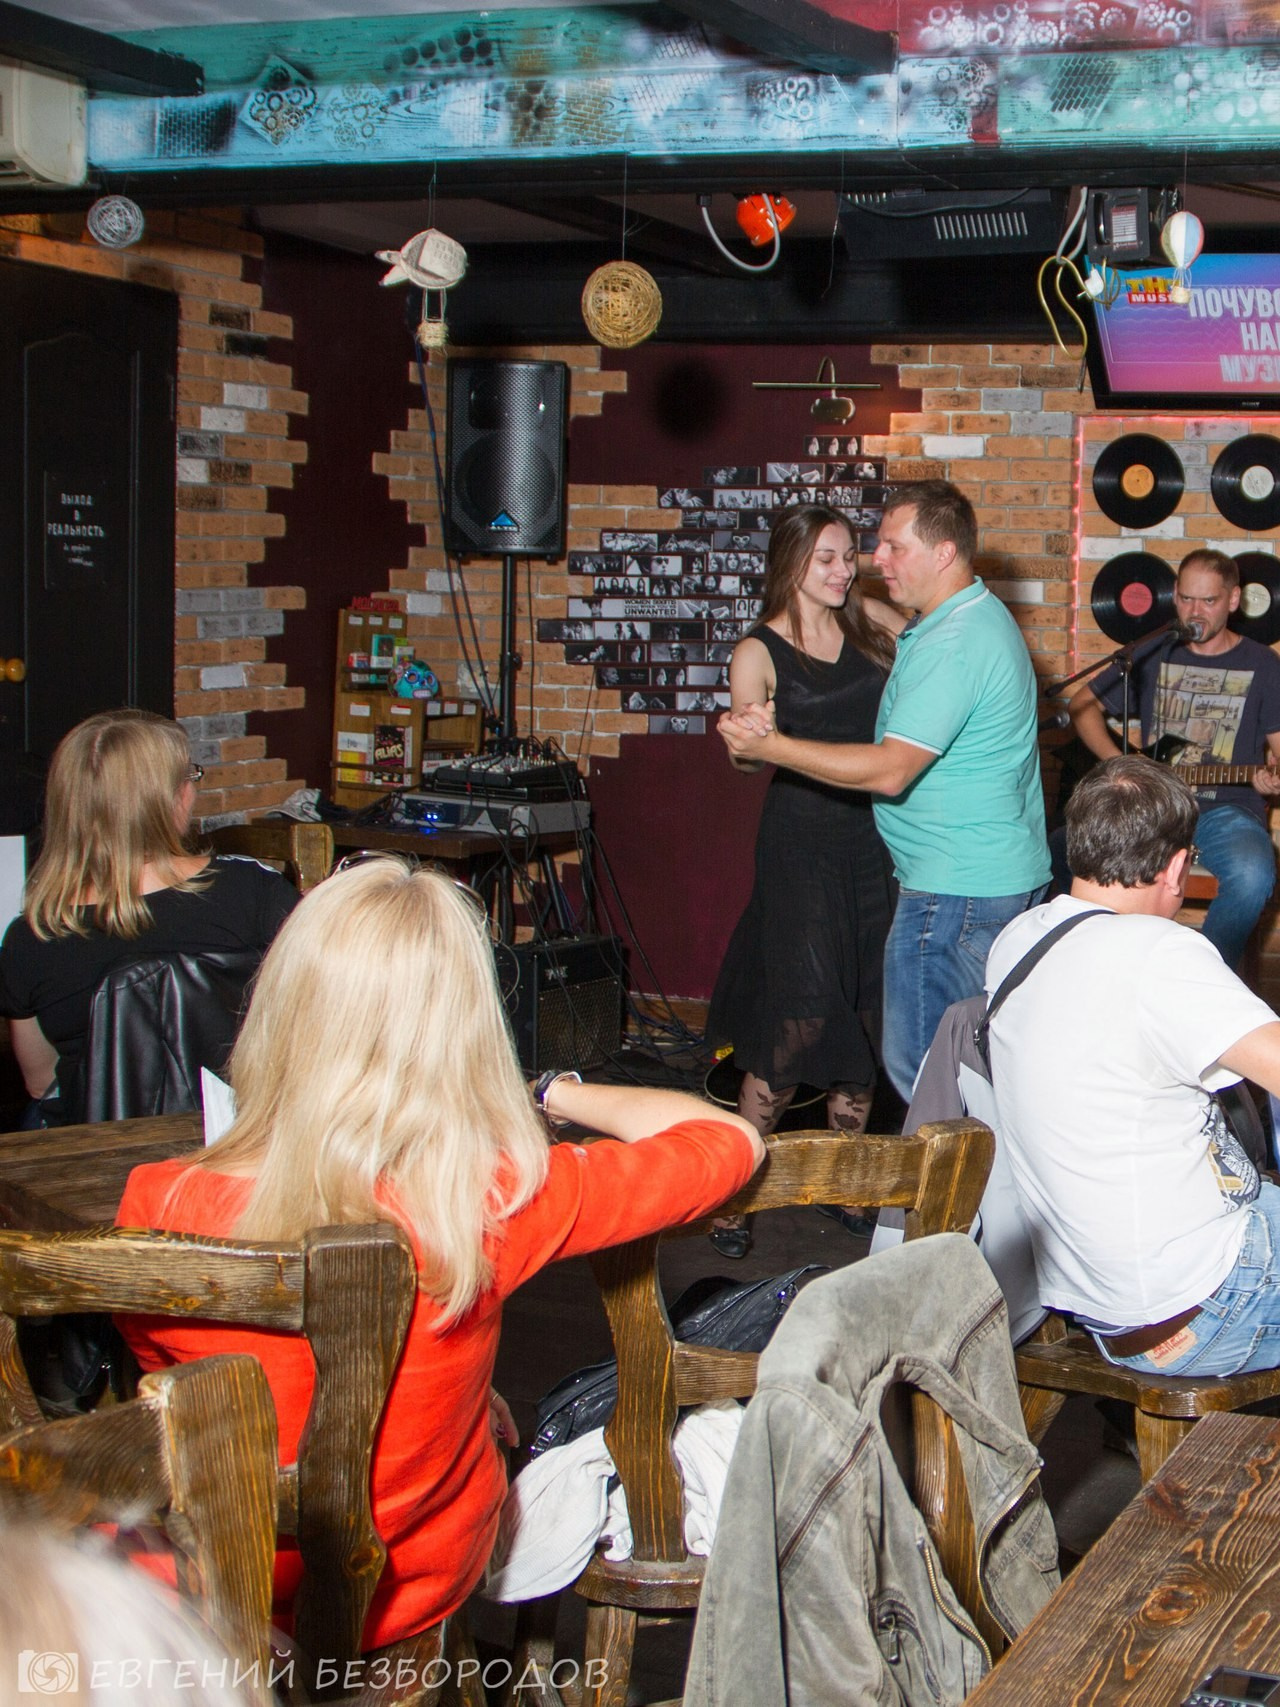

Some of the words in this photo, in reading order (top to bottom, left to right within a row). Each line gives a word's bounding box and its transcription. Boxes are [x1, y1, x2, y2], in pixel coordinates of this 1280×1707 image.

[1131, 293, 1174, 303] MUSI
[61, 493, 93, 506] ВЫХОД
[47, 523, 105, 537] РЕАЛЬНОСТЬ
